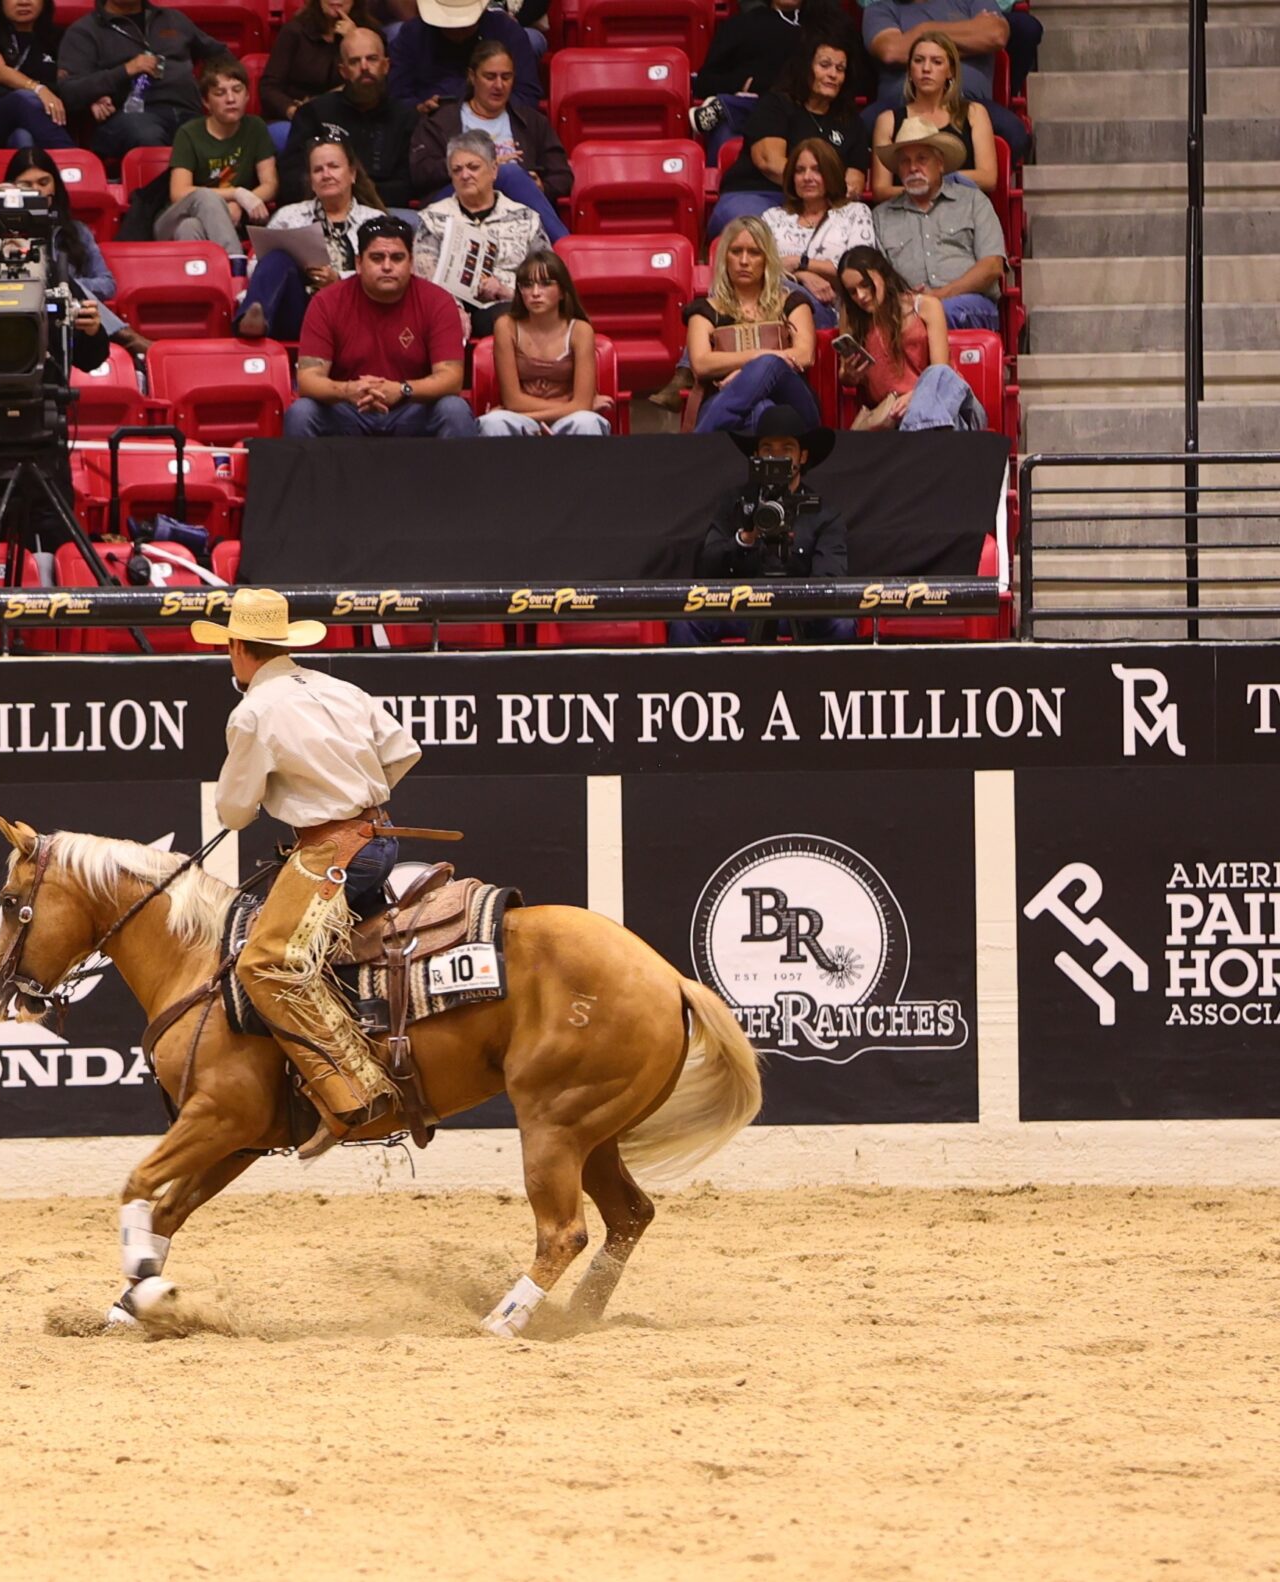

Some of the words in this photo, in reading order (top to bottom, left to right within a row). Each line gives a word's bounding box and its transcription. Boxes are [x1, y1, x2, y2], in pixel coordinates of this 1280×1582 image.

[497, 694, 618, 743] RUN
[638, 692, 744, 742] FOR
[762, 691, 799, 740] A
[820, 687, 1065, 739] MILLION
[1166, 893, 1280, 944] PAI
[449, 954, 474, 982] 10
[776, 993, 956, 1050] RANCHES
